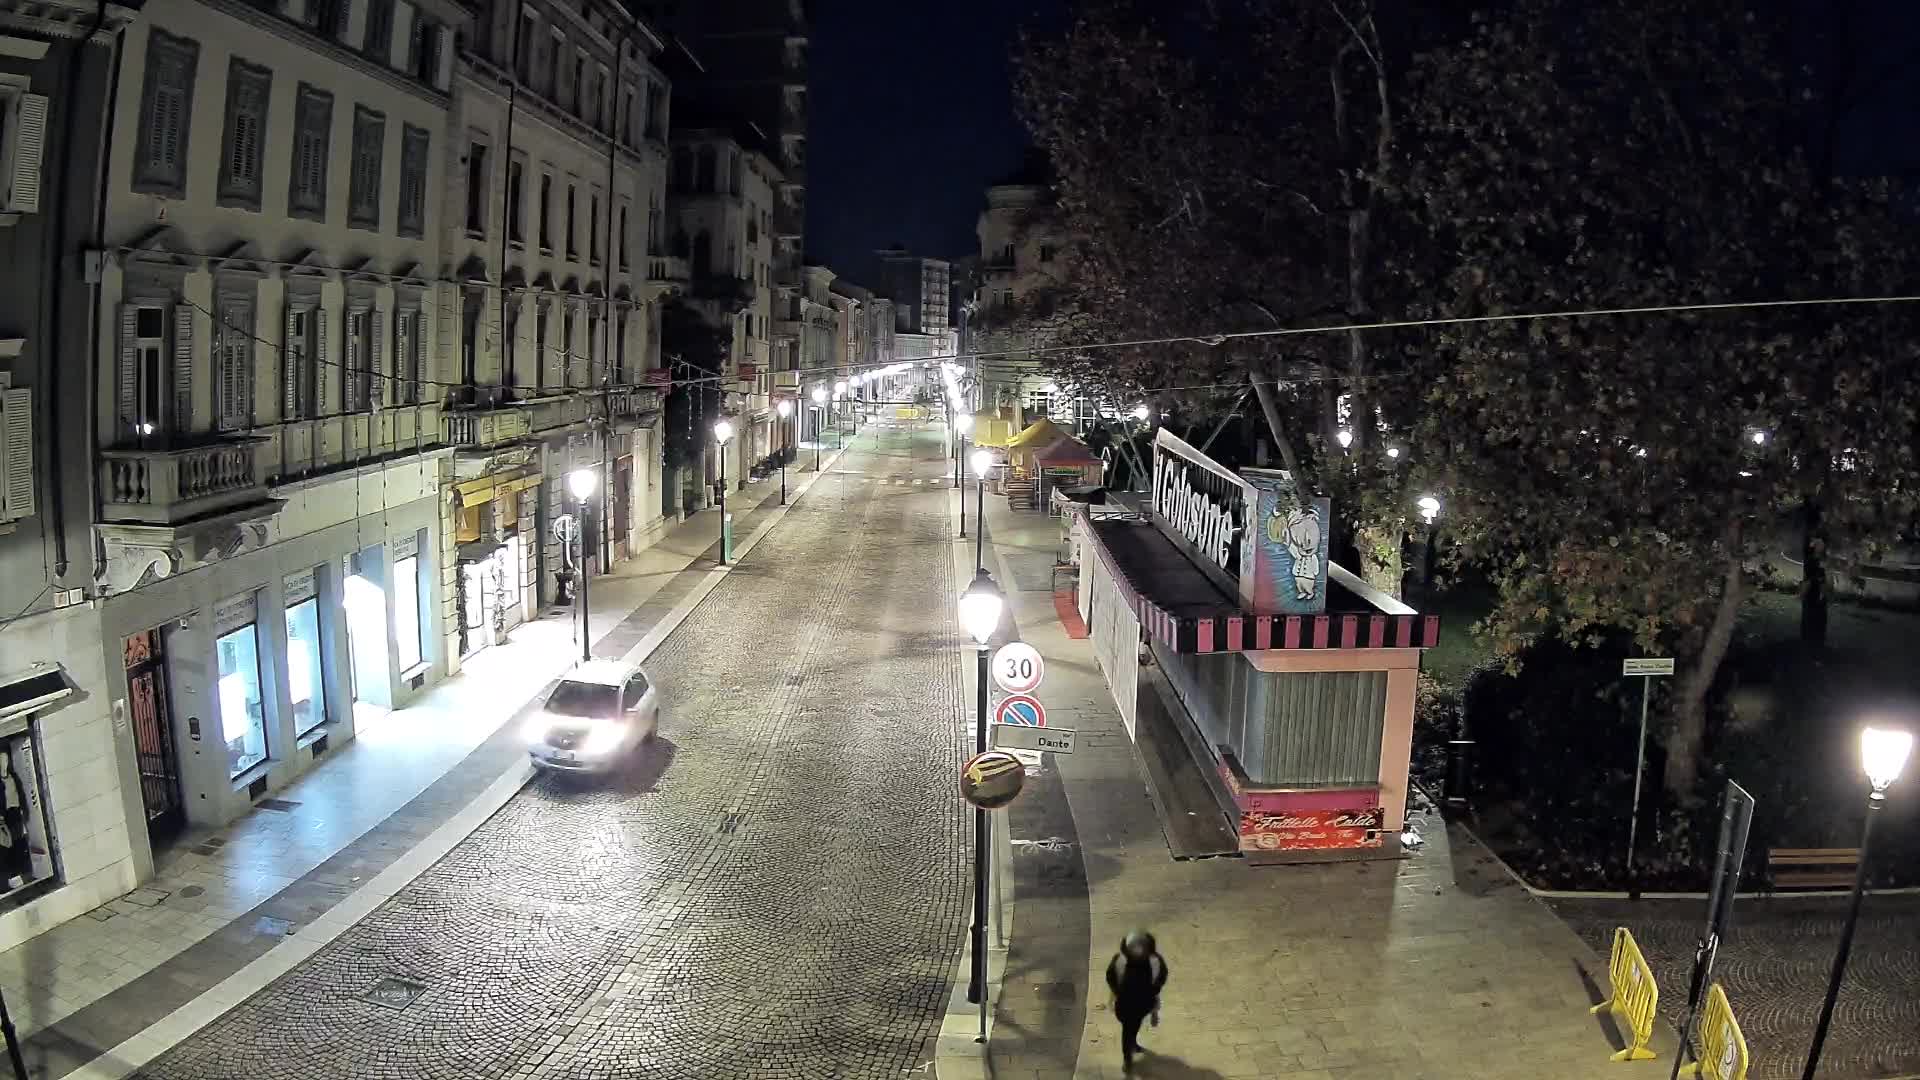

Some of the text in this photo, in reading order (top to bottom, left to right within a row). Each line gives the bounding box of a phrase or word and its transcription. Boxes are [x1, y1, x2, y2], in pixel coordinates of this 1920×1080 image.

[1163, 458, 1233, 569] Golosone
[1006, 658, 1032, 679] 30
[1038, 737, 1070, 749] Dante
